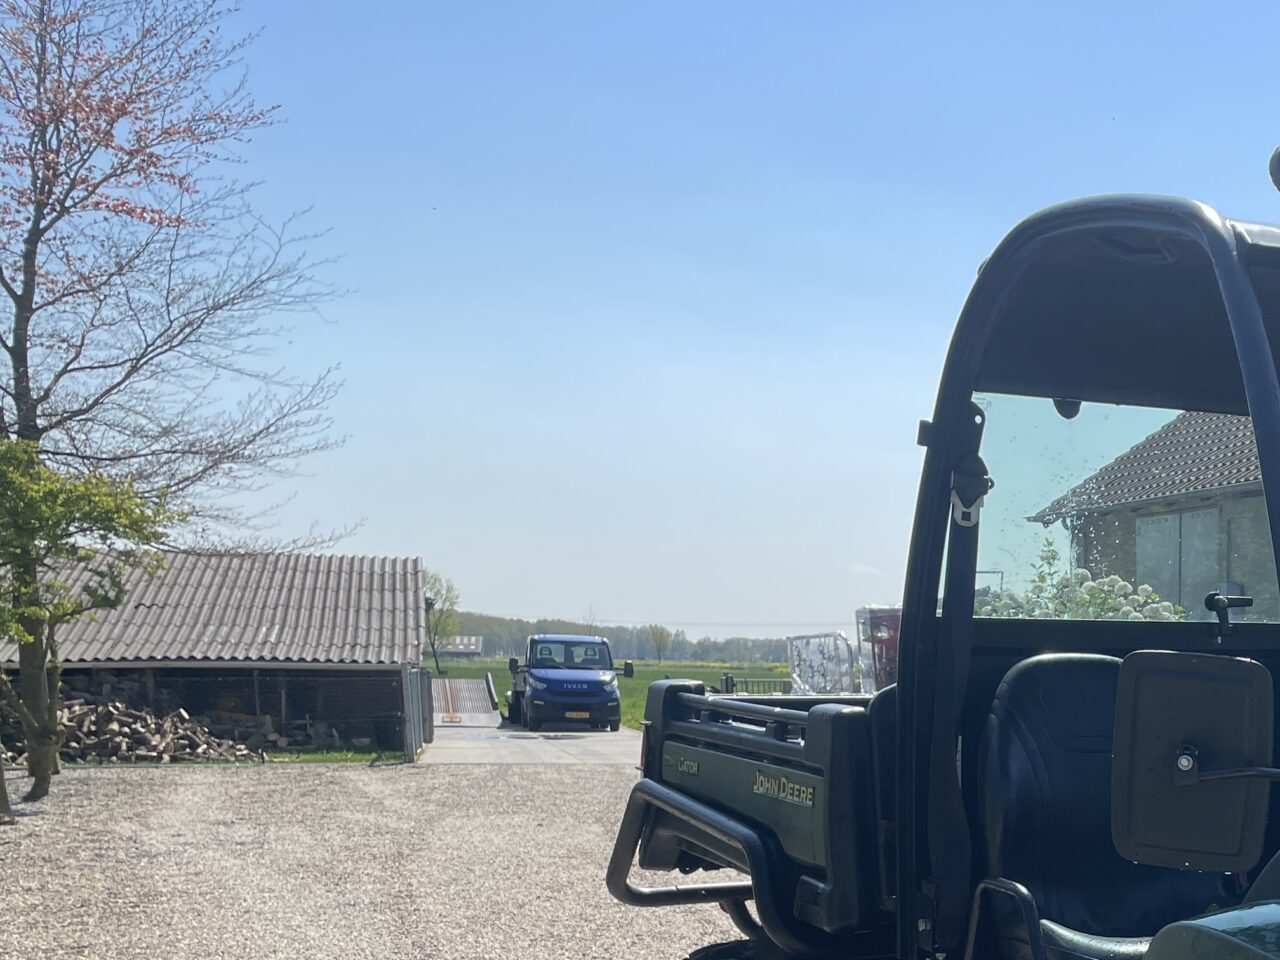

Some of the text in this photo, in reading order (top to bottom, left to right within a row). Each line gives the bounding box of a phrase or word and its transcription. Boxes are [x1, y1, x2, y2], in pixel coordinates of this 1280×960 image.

[677, 757, 699, 775] GATOR
[753, 771, 814, 806] JOHN DEERE
